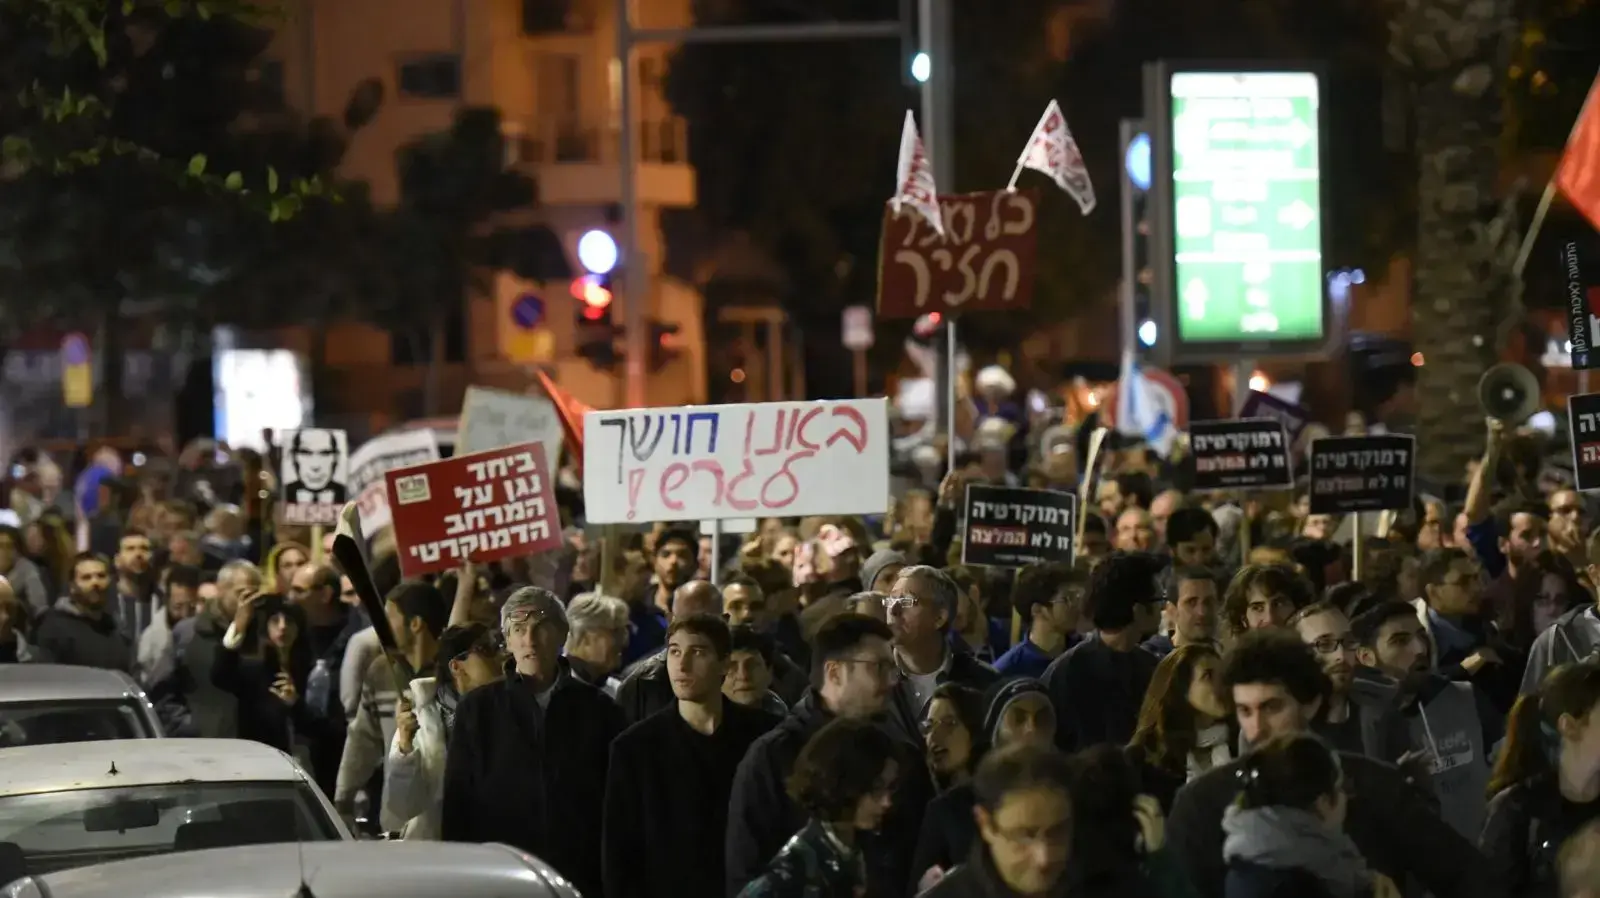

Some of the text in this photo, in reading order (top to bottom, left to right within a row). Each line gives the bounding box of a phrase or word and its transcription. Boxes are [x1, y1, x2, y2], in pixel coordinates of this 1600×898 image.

[744, 405, 868, 457] באנו
[1193, 431, 1281, 451] דמוקרטיה
[599, 411, 720, 485] חושך
[1249, 452, 1268, 468] לא
[1315, 449, 1408, 470] דמוקרטיה
[466, 451, 537, 482] ביחד
[1271, 454, 1284, 468] זו
[503, 473, 542, 503] נגן
[1368, 472, 1389, 489] לא
[1393, 474, 1406, 489] זו
[453, 484, 494, 509] על
[443, 496, 546, 536] המרחב
[971, 500, 1070, 526] דמוקרטיה
[409, 518, 550, 564] הדמוקרטי
[970, 527, 1070, 550] זו לא המלצה
